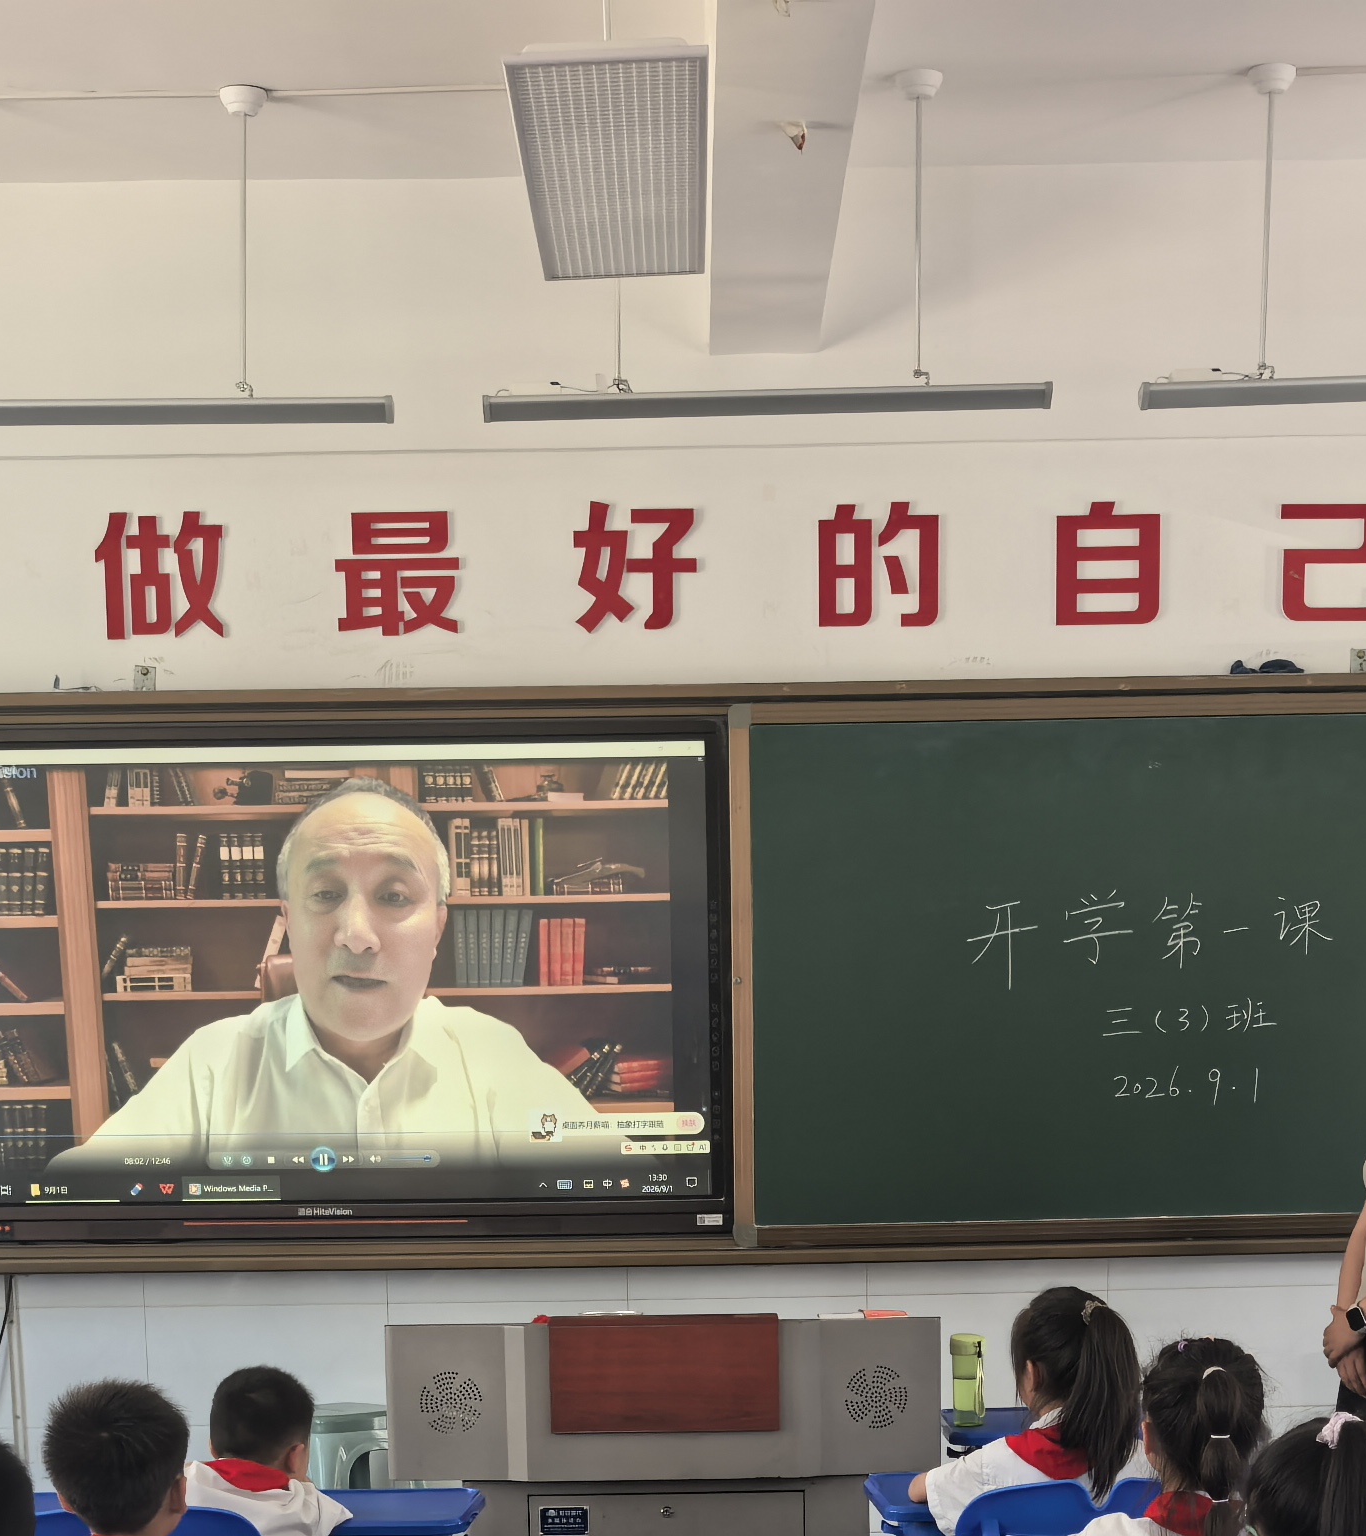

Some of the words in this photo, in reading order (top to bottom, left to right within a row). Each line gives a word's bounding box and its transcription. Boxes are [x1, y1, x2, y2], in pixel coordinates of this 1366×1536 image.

[967, 889, 1333, 990] 开学第一课
[1113, 1066, 1259, 1106] 2026.9.1
[151, 1156, 171, 1165] 12:46
[648, 1173, 668, 1182] 13:30
[44, 1186, 68, 1195] 9月1日
[203, 1184, 235, 1193] Windows
[238, 1184, 261, 1193] Media
[642, 1185, 673, 1194] 2026/9/1
